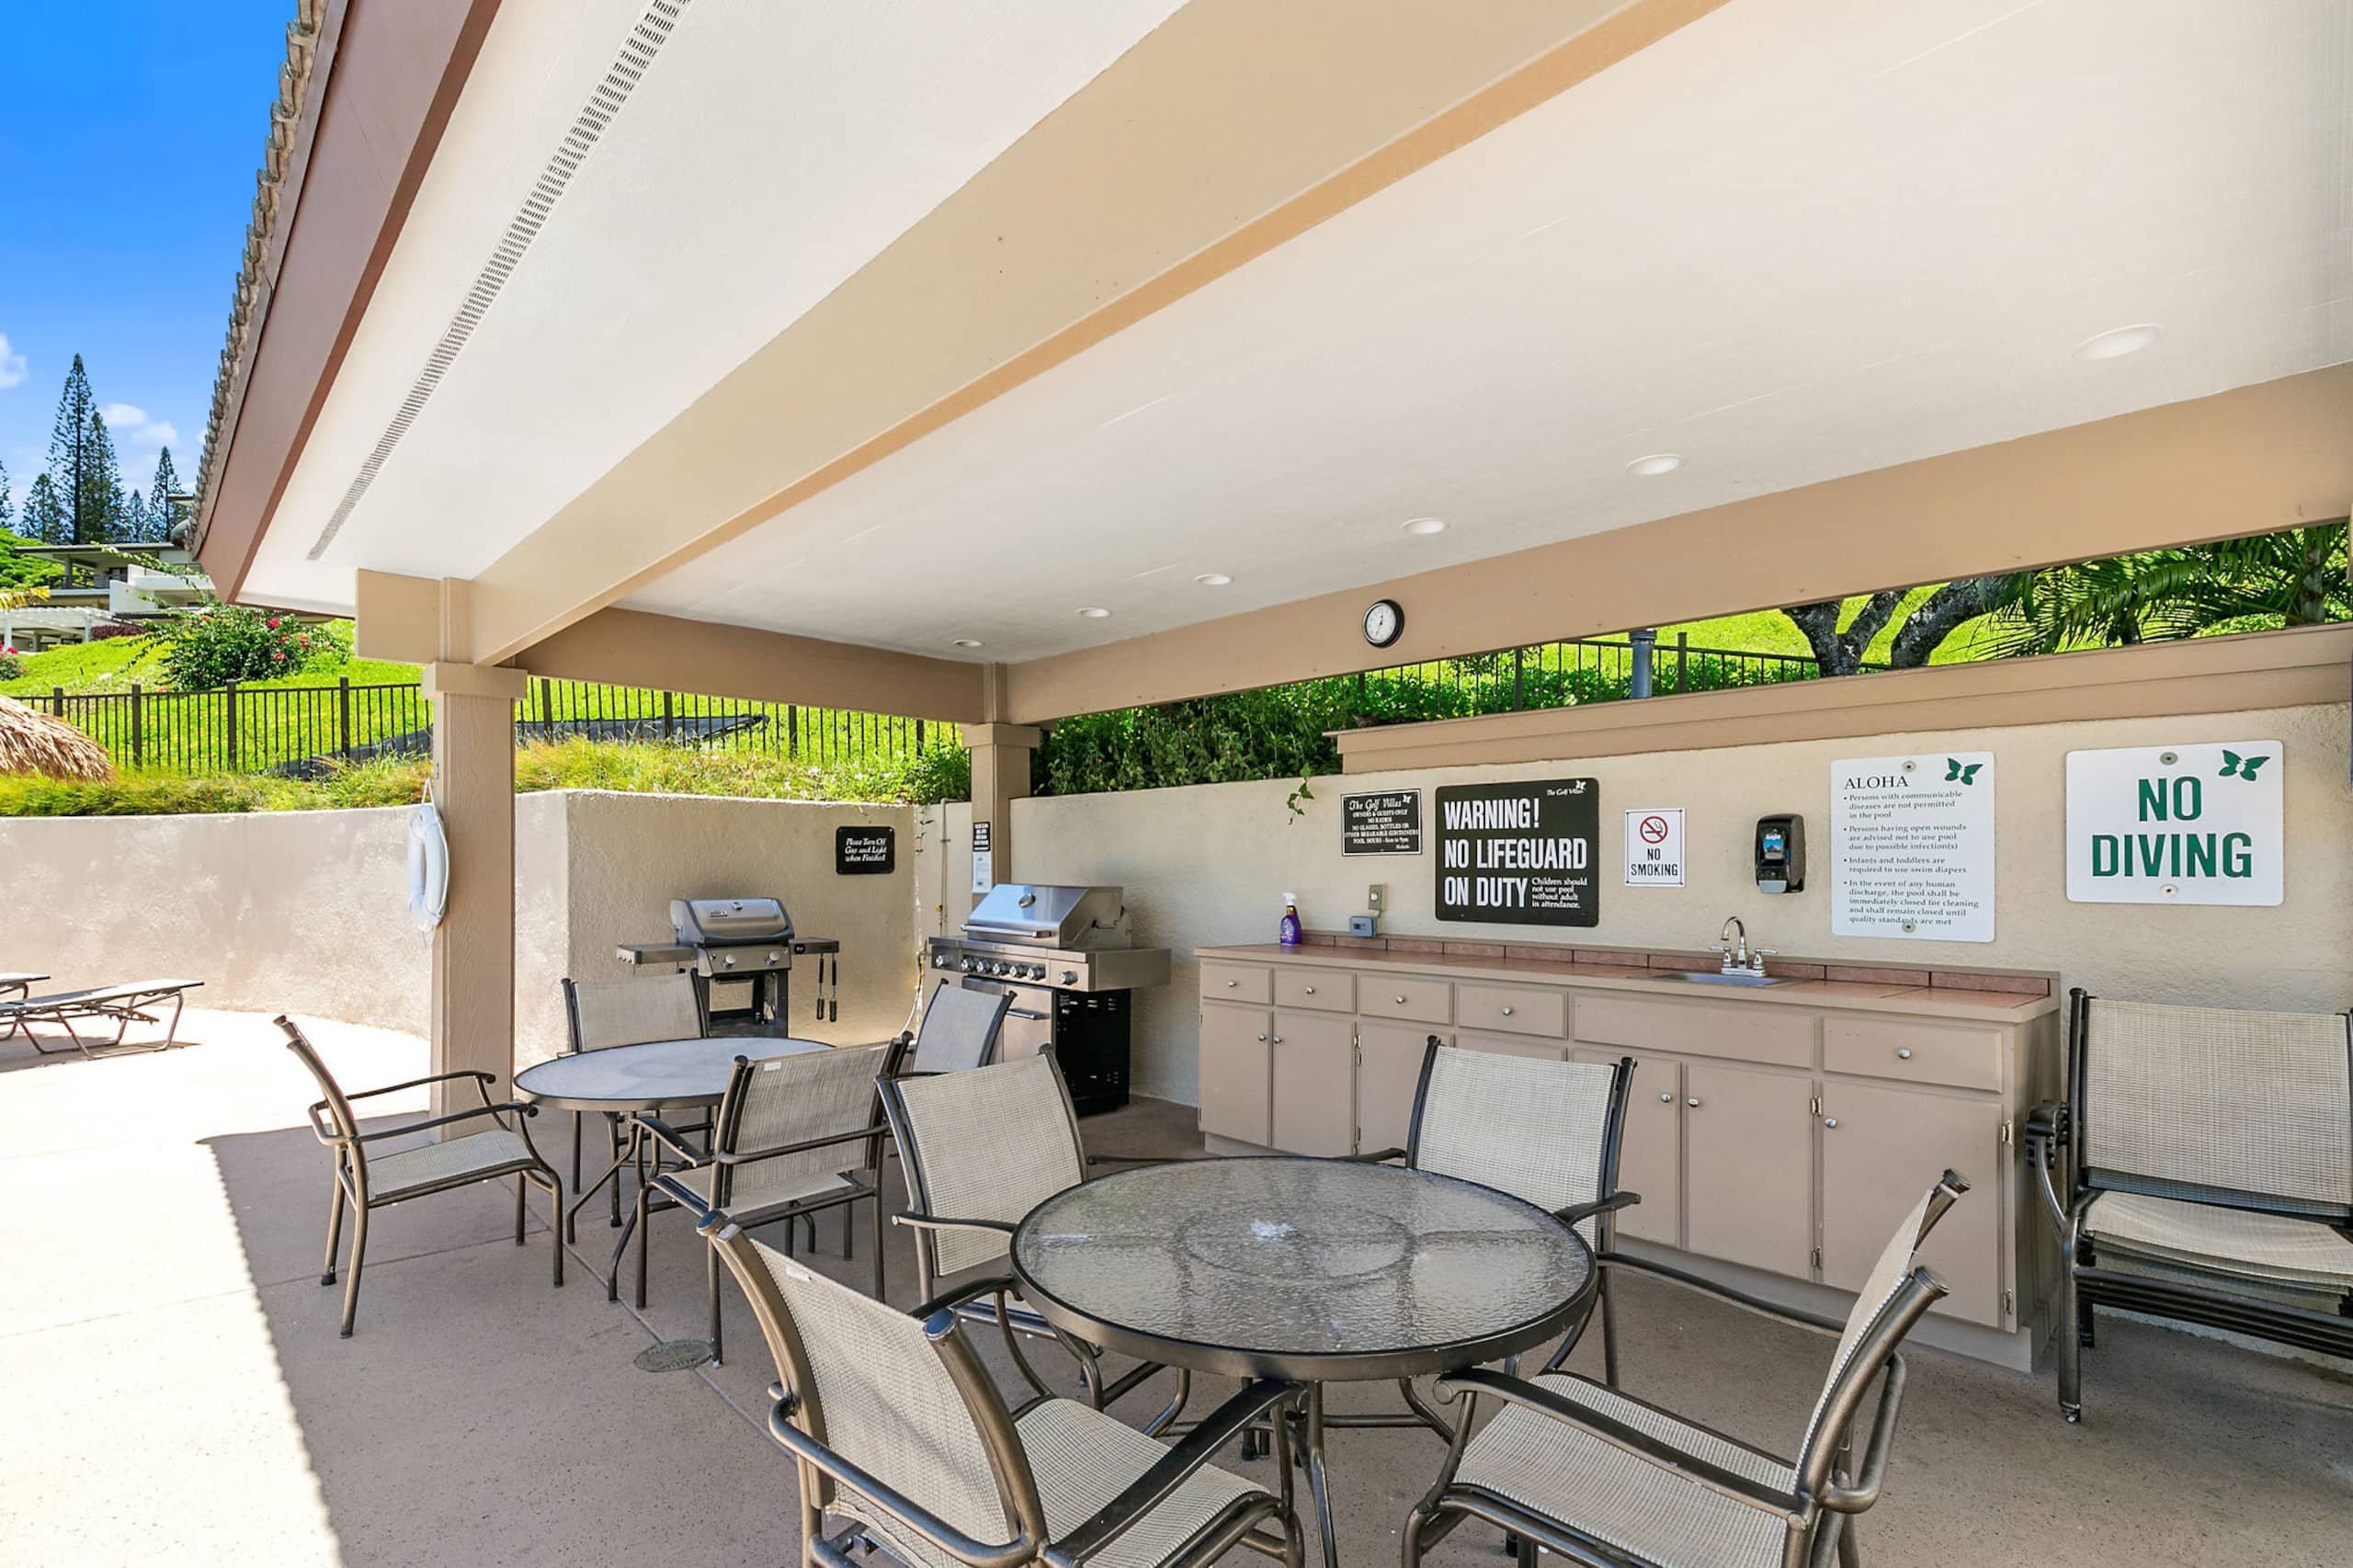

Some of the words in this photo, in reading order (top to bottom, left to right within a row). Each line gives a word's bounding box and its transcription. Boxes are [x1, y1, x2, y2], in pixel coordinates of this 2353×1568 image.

[1845, 776, 1908, 790] ALOHA
[1349, 801, 1363, 810] The
[1365, 799, 1381, 812] Golf
[1382, 798, 1401, 808] Villas
[1914, 801, 1955, 809] permitted
[2139, 777, 2201, 821] NO
[1444, 798, 1539, 830] WARNING!
[1874, 812, 1892, 820] pool
[1938, 833, 1957, 841] pool
[1445, 839, 1469, 868] NO
[1477, 838, 1586, 869] LIFEGUARD
[1647, 847, 1661, 860] NO
[2093, 833, 2252, 878] DIVING
[1631, 864, 1677, 876] SMOKING
[1445, 876, 1469, 905] ON
[1477, 878, 1528, 907] DUTY
[1559, 886, 1574, 894] pool
